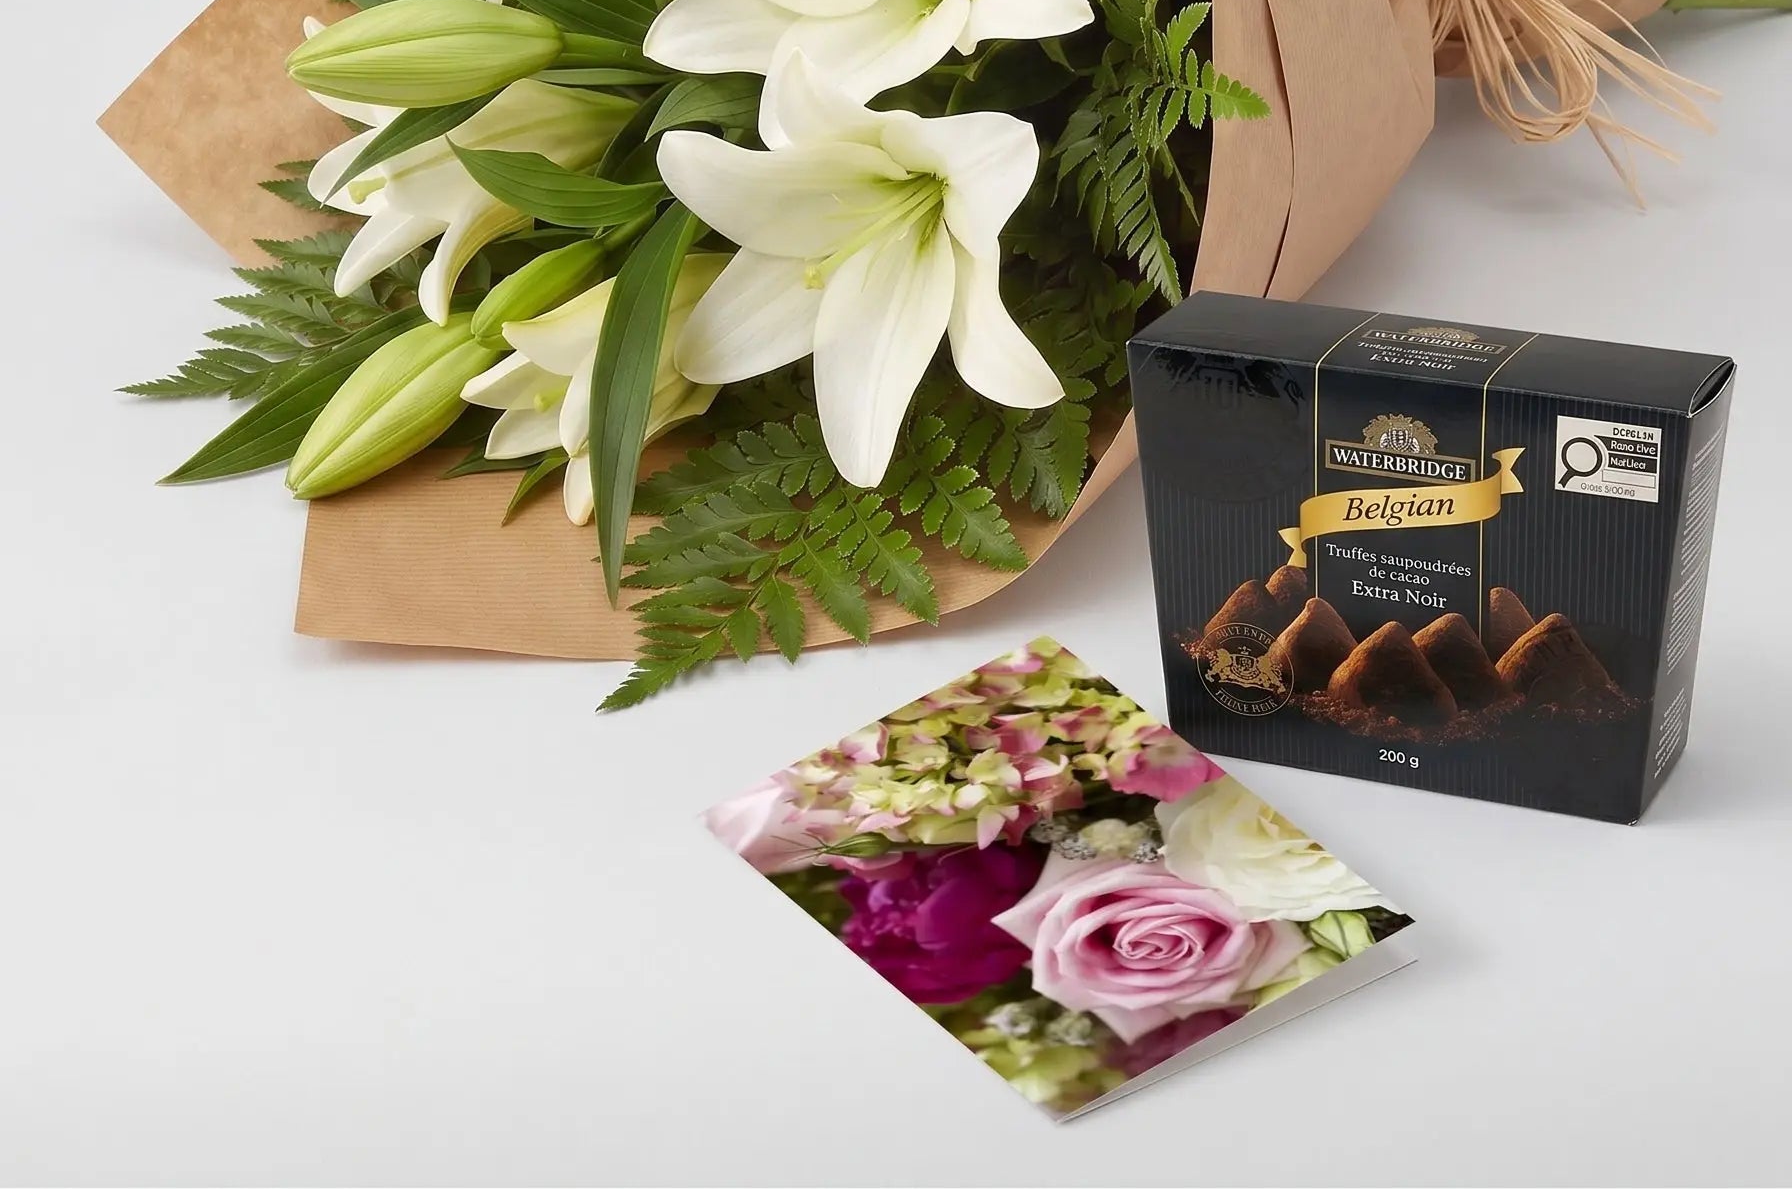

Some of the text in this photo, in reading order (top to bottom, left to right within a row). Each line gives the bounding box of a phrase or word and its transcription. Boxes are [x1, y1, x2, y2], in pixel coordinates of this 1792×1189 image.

[1333, 447, 1466, 481] WATERBRIDGE
[1342, 493, 1455, 527] Belgian
[1325, 543, 1472, 577] Truffes saupoudrées
[1368, 566, 1430, 586] de cacao
[1351, 580, 1447, 609] Extra Noir
[1379, 749, 1419, 768] 200 g
